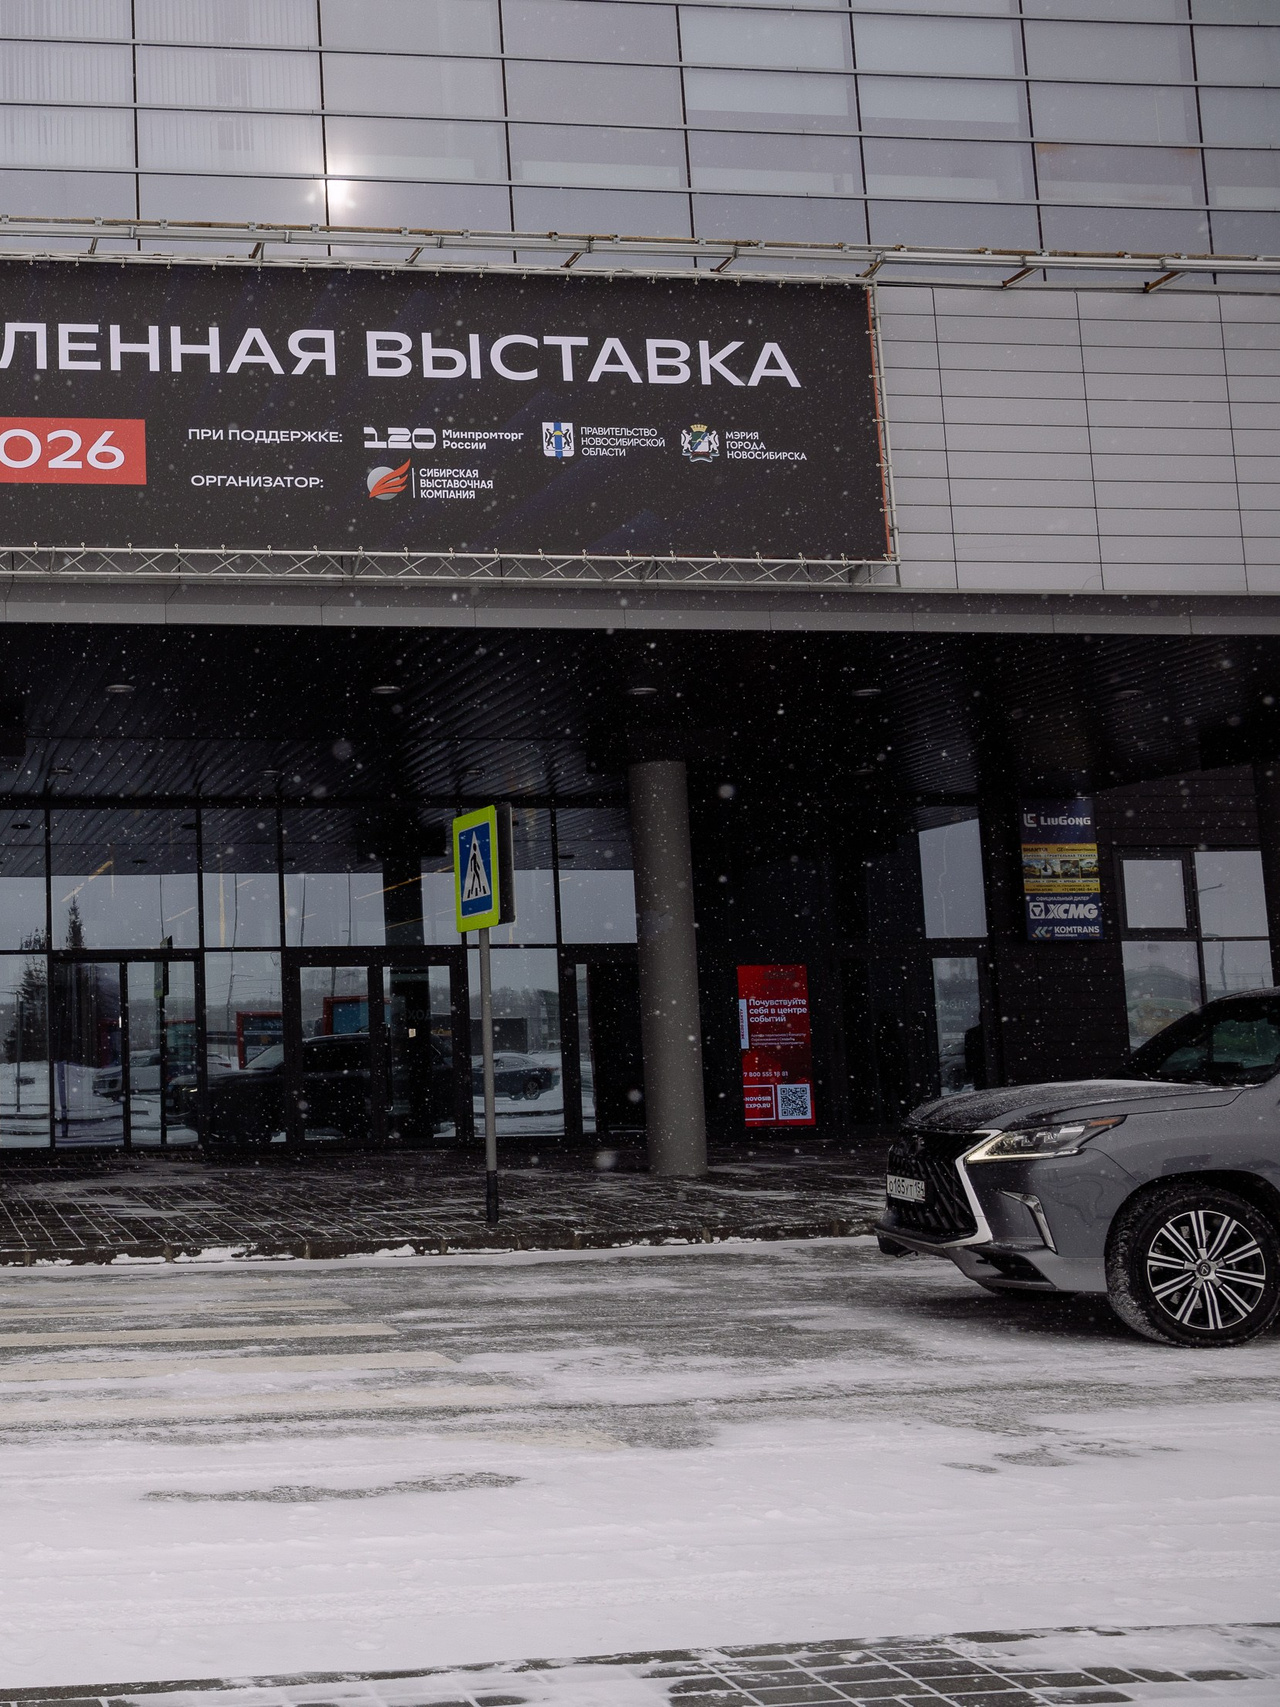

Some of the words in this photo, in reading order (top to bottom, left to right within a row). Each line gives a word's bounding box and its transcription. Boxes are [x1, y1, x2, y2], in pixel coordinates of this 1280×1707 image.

[366, 331, 802, 388] ВЫСТАВКА
[188, 428, 224, 441] ПРИ
[228, 429, 343, 444] ПОДДЕРЖКЕ:
[442, 429, 525, 442] Минпромторг
[580, 426, 658, 437] ПРАВИТЕЛЬСТВО
[725, 431, 760, 441] МЭРИЯ
[363, 427, 437, 450] 120
[581, 436, 666, 448] НОВОСИБИРСКОЙ
[442, 439, 487, 450] России
[725, 441, 767, 451] ГОРОДА
[581, 447, 627, 457] ОБЛАСТИ
[726, 450, 808, 461] НОВОСИБИРСКА
[419, 467, 479, 479] СИБИРСКАЯ
[190, 474, 324, 489] ОРГАНИЗАТОР:
[420, 479, 494, 490] ВЫСТАВОЧНАЯ
[420, 489, 476, 500] КОМПАНИЯ
[1045, 903, 1099, 920] XCMG
[1054, 925, 1100, 934] KOMTRANS
[749, 998, 807, 1007] Почувствуйте
[749, 1014, 787, 1023] событий
